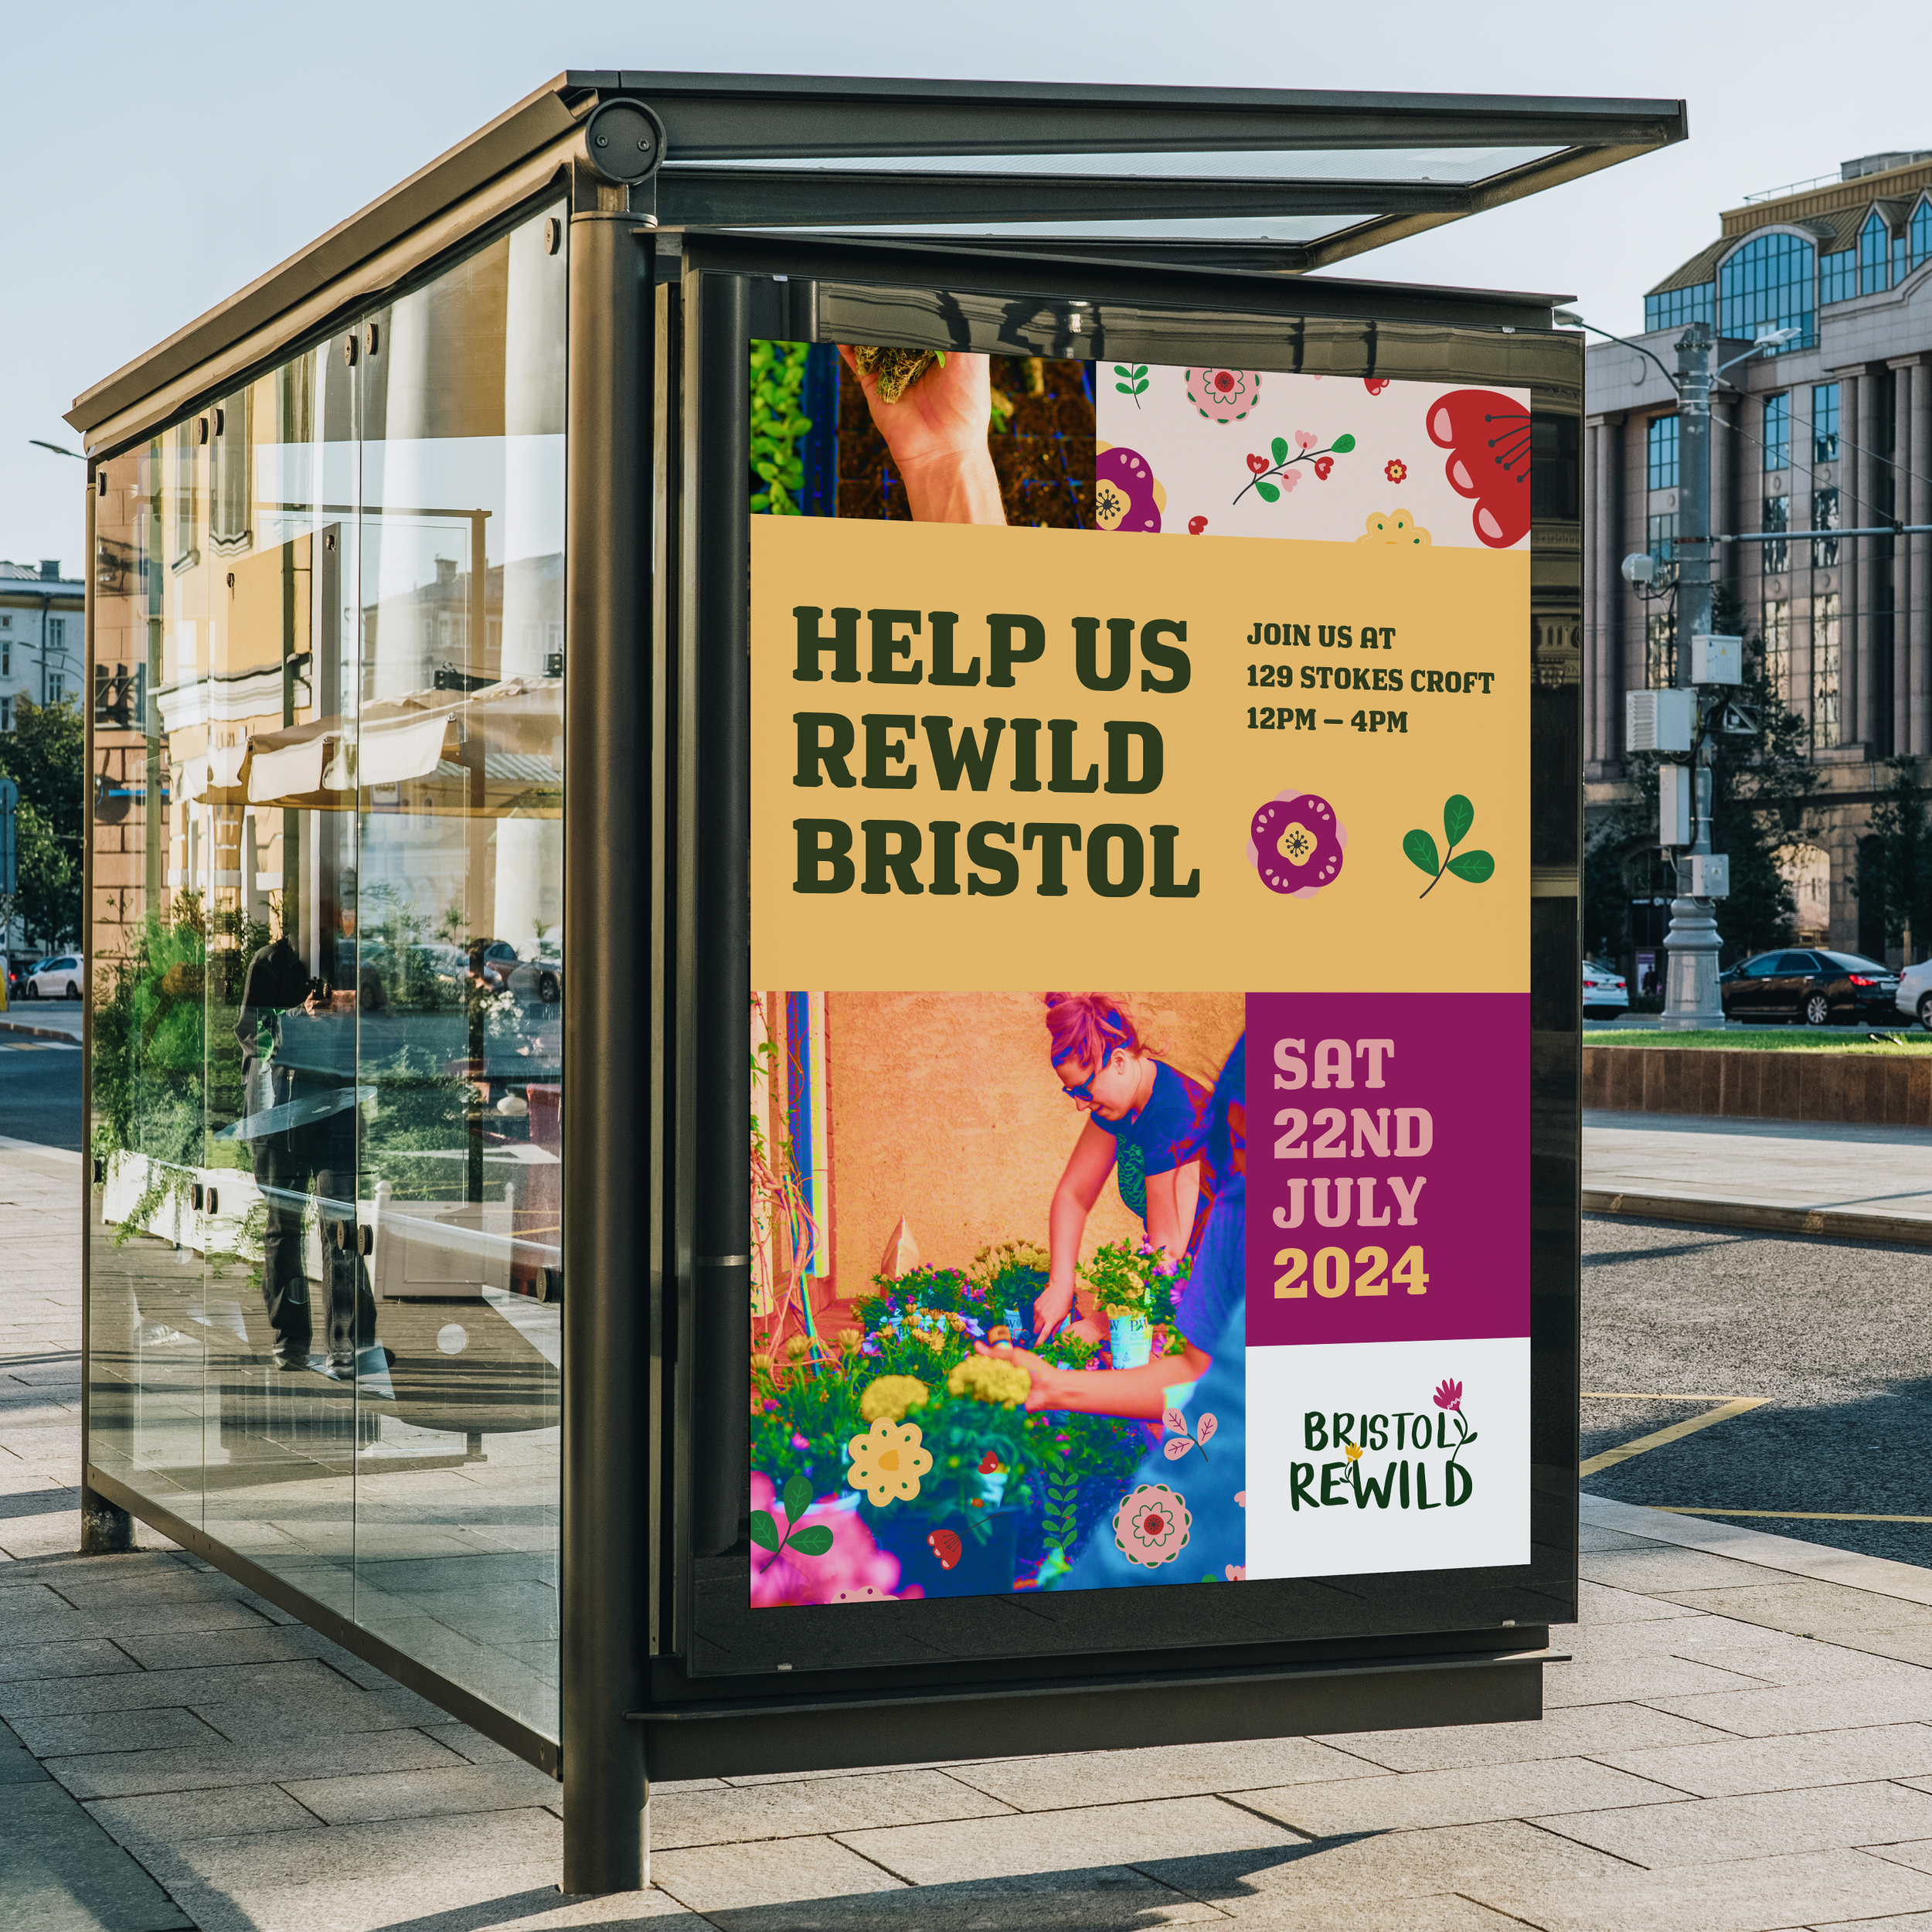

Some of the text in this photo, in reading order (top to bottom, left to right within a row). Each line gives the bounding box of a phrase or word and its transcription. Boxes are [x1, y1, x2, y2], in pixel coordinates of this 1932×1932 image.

[793, 606, 1191, 693] HELP US
[1247, 623, 1396, 649] JOIN US AT
[1247, 665, 1495, 694] 129 STOKES CROFT
[1247, 707, 1316, 730] 12PM
[1351, 710, 1407, 733] 4PM
[793, 712, 1163, 794] REWILD
[793, 818, 1199, 898] BRISTOL
[1274, 1039, 1394, 1090] SAT
[1274, 1108, 1433, 1158] 22ND
[1273, 1176, 1426, 1228] JULY
[1274, 1246, 1429, 1298] 2024
[1304, 1411, 1456, 1451] BRISTOL
[1291, 1460, 1472, 1512] REWILD
